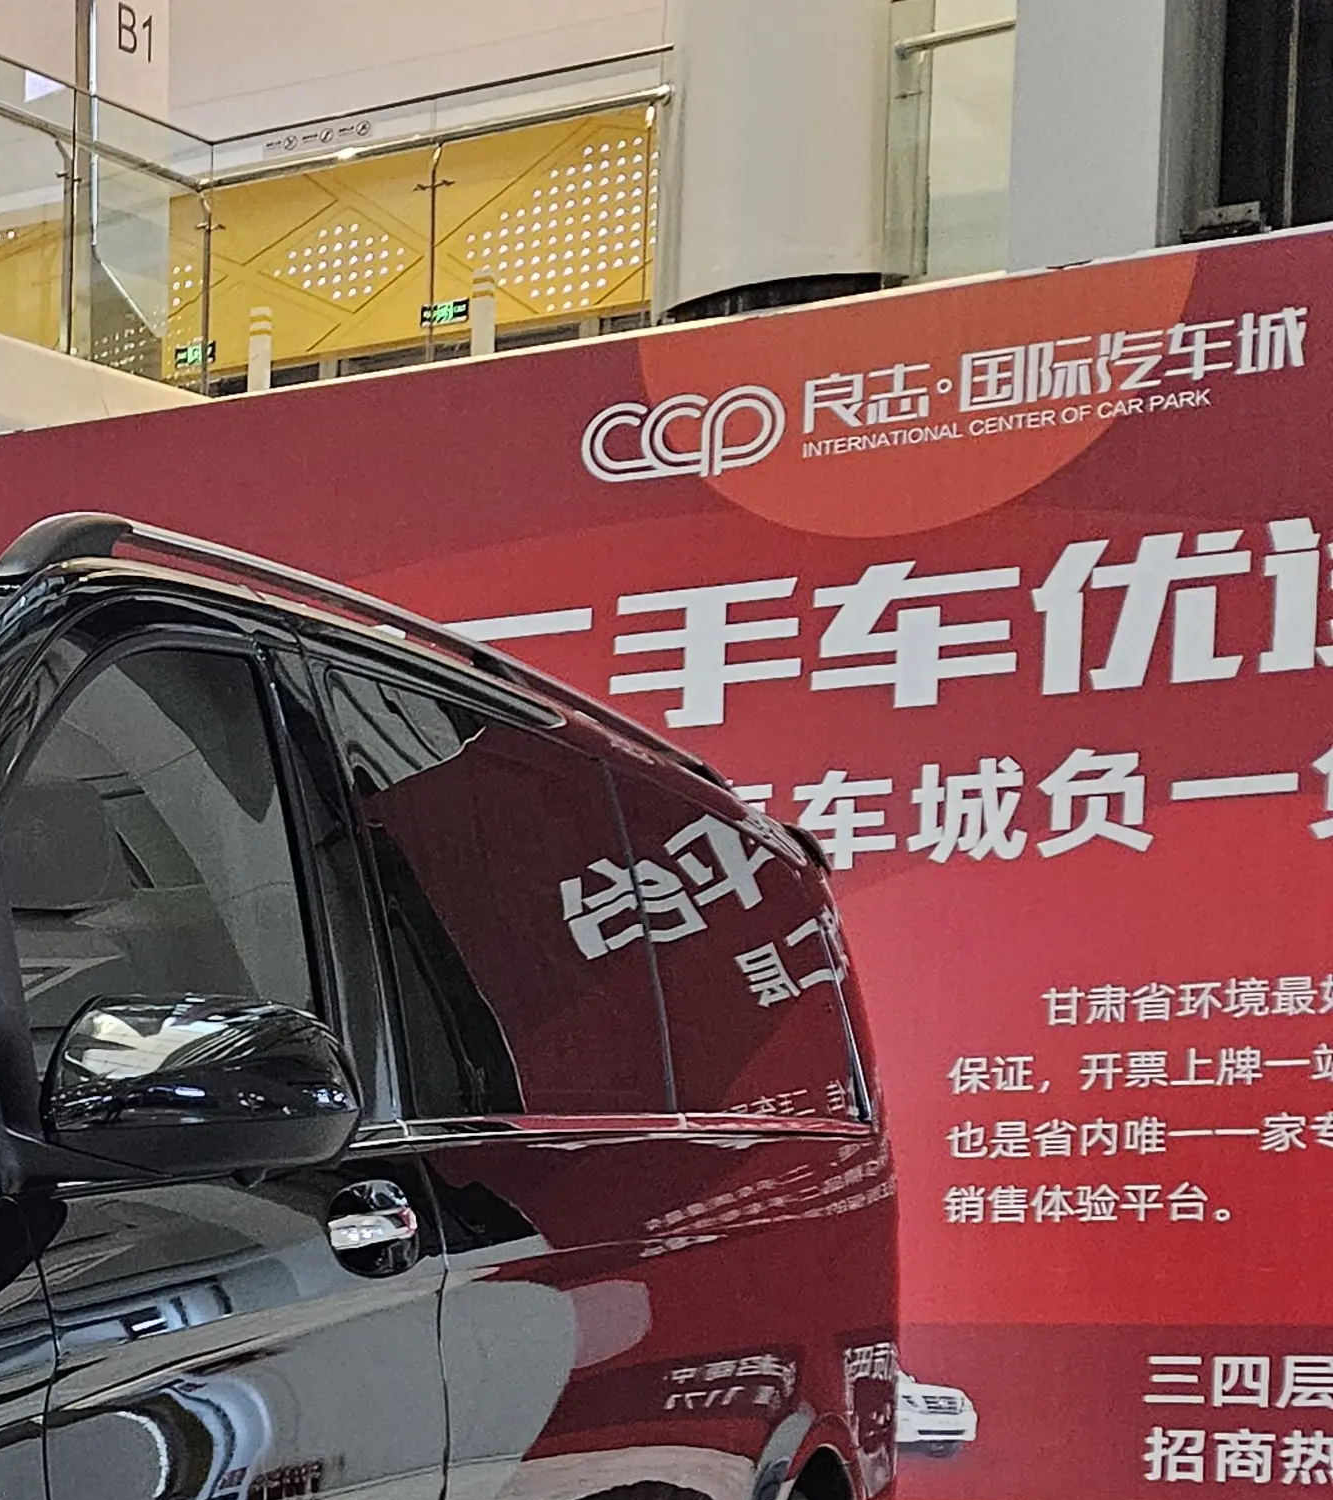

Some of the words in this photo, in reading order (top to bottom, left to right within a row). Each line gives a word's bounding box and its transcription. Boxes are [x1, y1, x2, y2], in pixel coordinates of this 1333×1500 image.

[117, 2, 153, 63] B1
[802, 423, 963, 459] INTERNATIONAL
[969, 412, 1057, 437] CENTER
[1061, 407, 1092, 427] OF
[1097, 398, 1147, 421] CAR
[1150, 389, 1211, 413] PARK
[728, 747, 1333, 870] 车城负一
[943, 1182, 1233, 1225] 销售体验平台。
[1142, 1355, 1333, 1409] 三四层
[1142, 1425, 1333, 1485] 招商热
